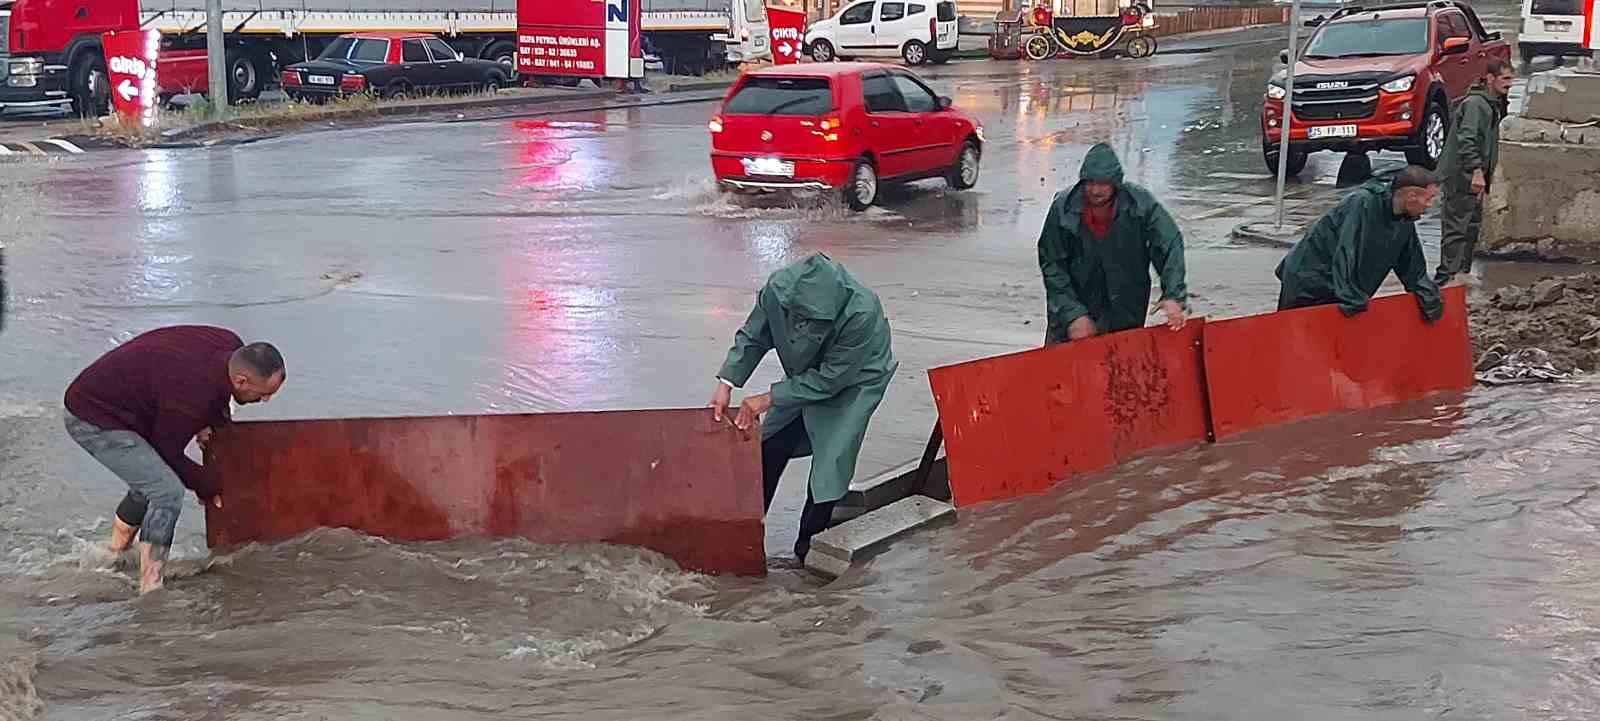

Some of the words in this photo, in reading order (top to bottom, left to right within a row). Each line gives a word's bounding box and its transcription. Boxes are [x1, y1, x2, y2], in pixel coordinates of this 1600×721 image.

[536, 36, 558, 44] PETROL
[772, 27, 798, 41] ÇIKIŞ
[109, 55, 146, 79] GİRİŞ
